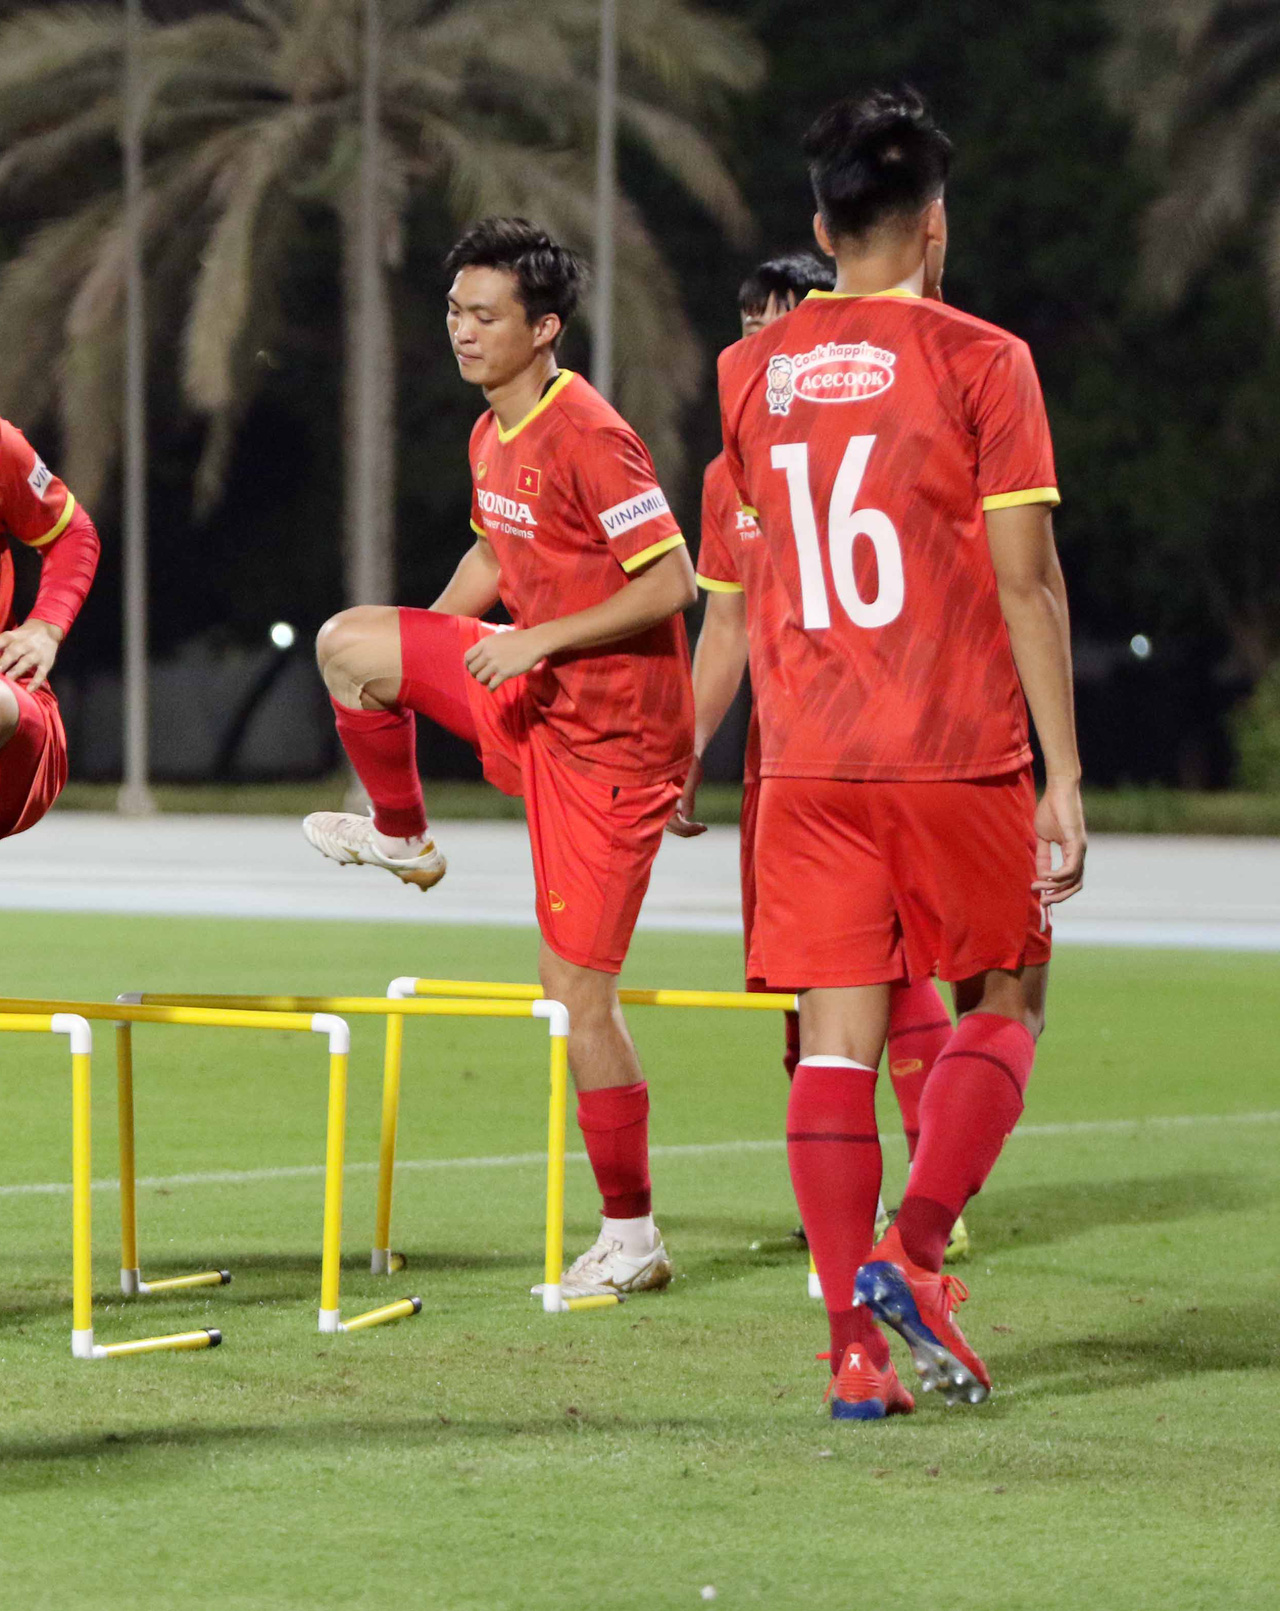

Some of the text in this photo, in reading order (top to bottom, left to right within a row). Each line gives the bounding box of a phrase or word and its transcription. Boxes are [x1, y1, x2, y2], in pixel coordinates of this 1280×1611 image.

[794, 347, 824, 369] Cook
[477, 488, 538, 525] HONDA
[770, 434, 905, 630] 16
